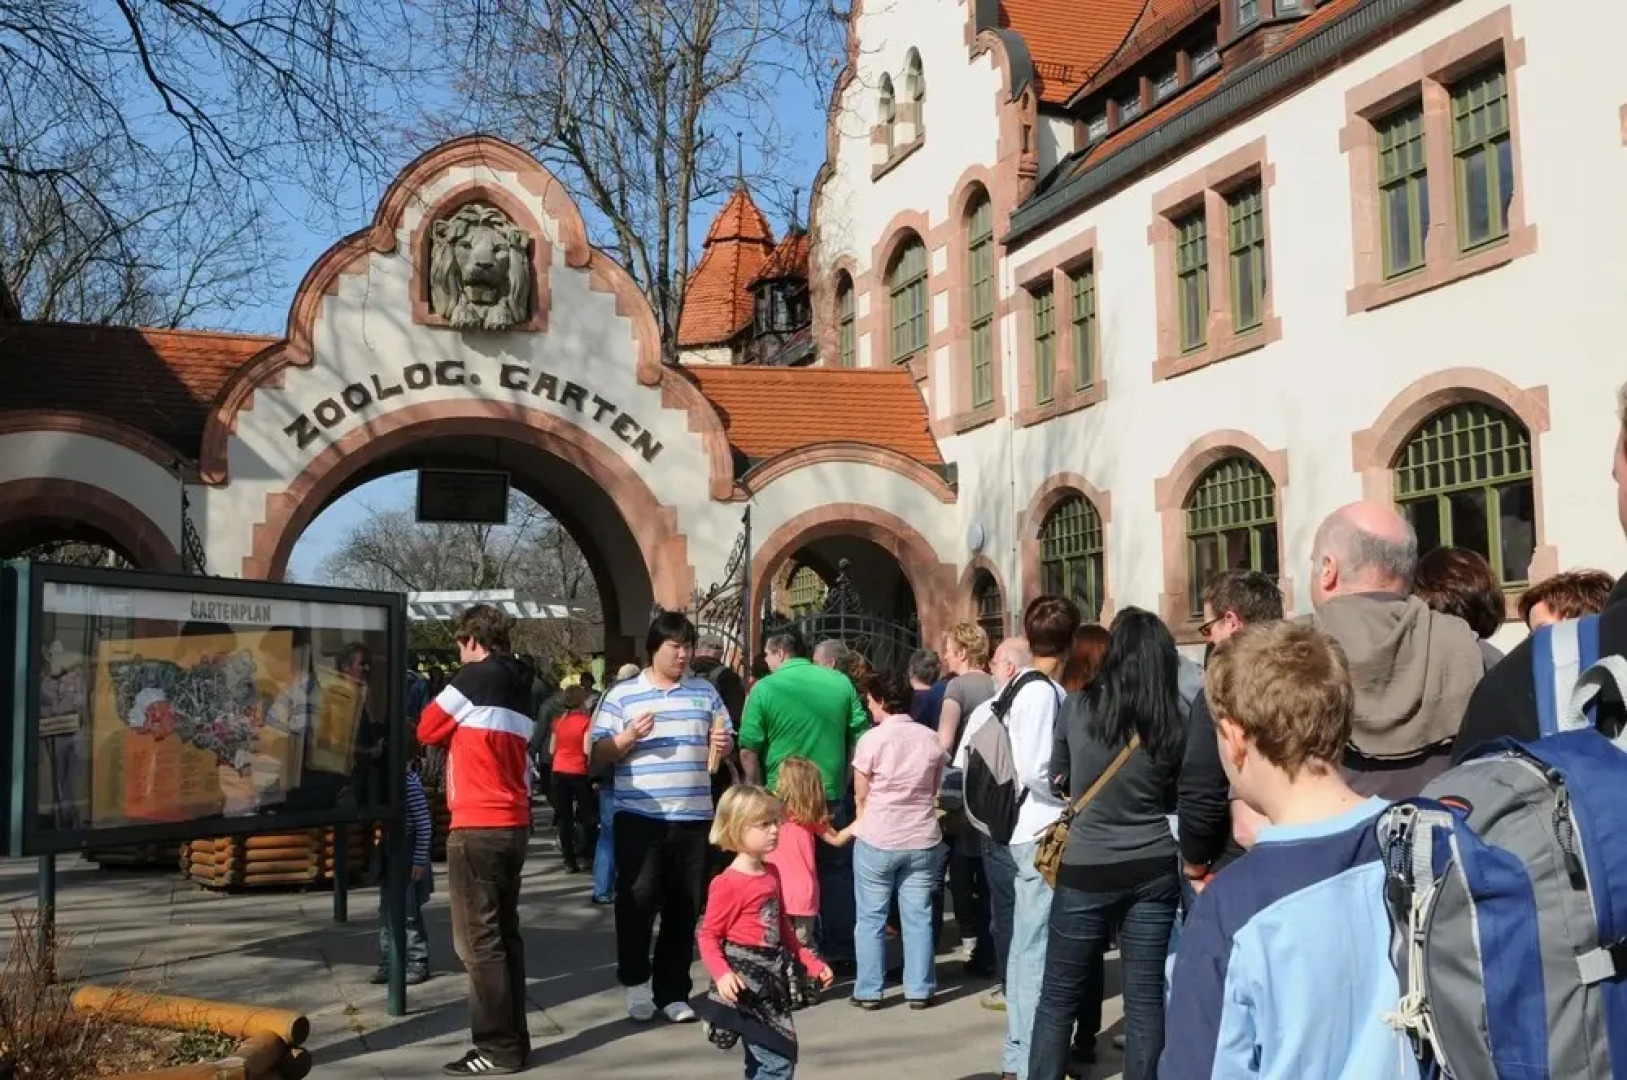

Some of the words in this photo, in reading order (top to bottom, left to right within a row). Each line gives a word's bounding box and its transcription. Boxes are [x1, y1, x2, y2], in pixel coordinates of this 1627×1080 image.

[284, 360, 482, 451] ZOOLOG.
[499, 363, 663, 463] GARTEN
[190, 599, 271, 623] GARTENPLAN
